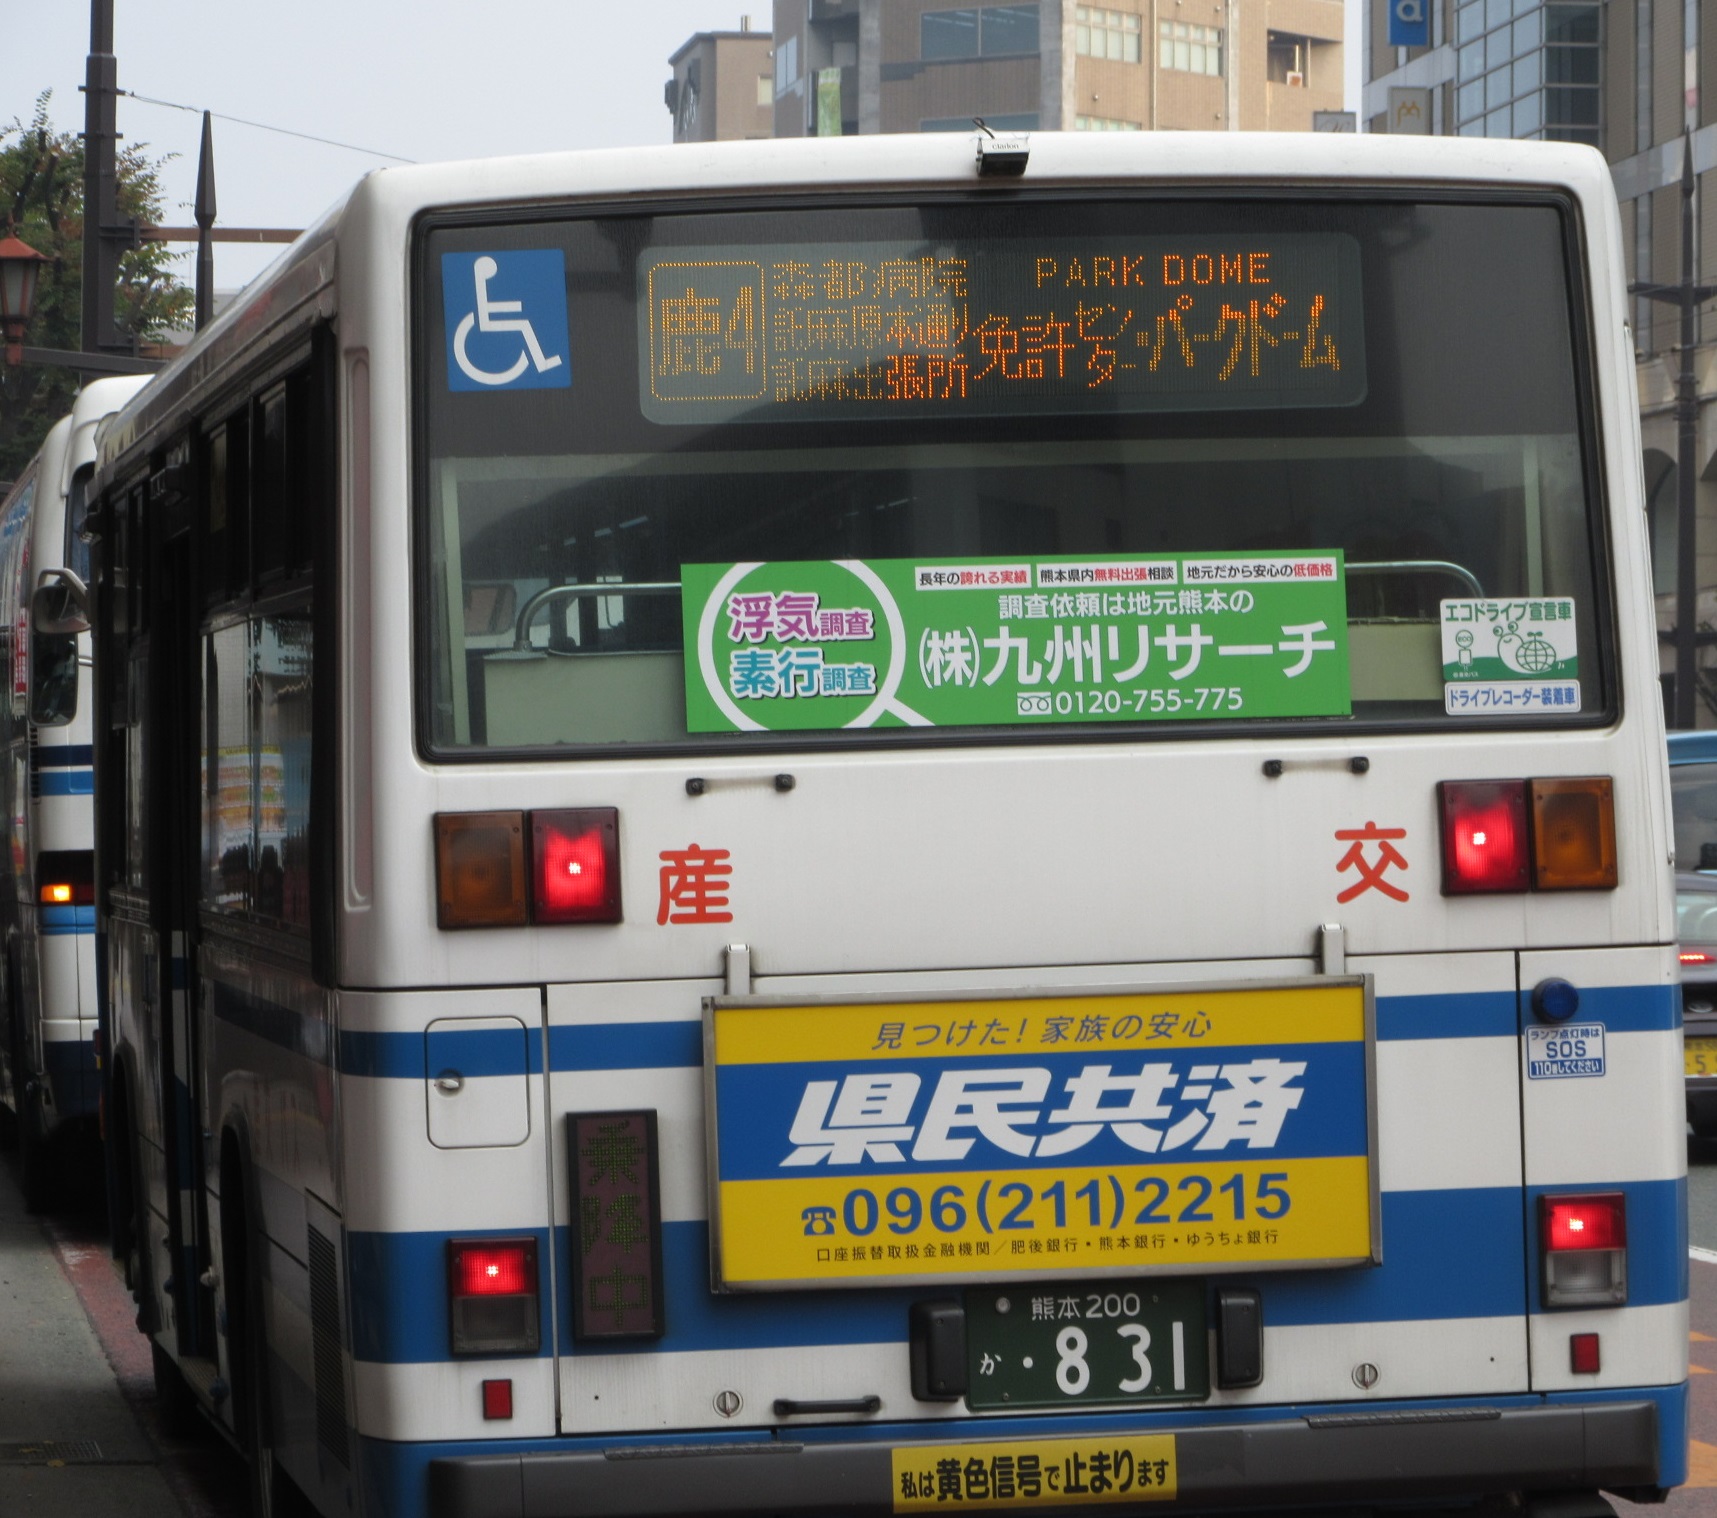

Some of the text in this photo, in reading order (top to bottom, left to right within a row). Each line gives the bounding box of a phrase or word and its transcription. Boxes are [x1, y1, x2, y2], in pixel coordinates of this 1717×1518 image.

[773, 257, 968, 300] 森都病院
[1035, 252, 1271, 288] PARK DOME
[919, 562, 1334, 586] 長年の誇れる実績 熊本県内無料出張相談 地元だから安心の低価格
[728, 593, 871, 640] 浮気調査
[998, 589, 1255, 620] 調査依頼は地元熊本の
[1445, 601, 1572, 623] エコドライブ宣言車
[732, 648, 874, 695] 素行調査
[1055, 687, 1243, 715] 0120-755-775
[1450, 687, 1576, 708] ドライブレコーダー装着車
[656, 820, 1410, 926] 産 交
[1546, 1040, 1587, 1059] SOS
[778, 1058, 1308, 1168] 県民共済
[842, 1172, 1293, 1237] 096(211)2215
[980, 1352, 1002, 1376] か
[901, 1450, 1170, 1503] 私は黄色信号で止まります
